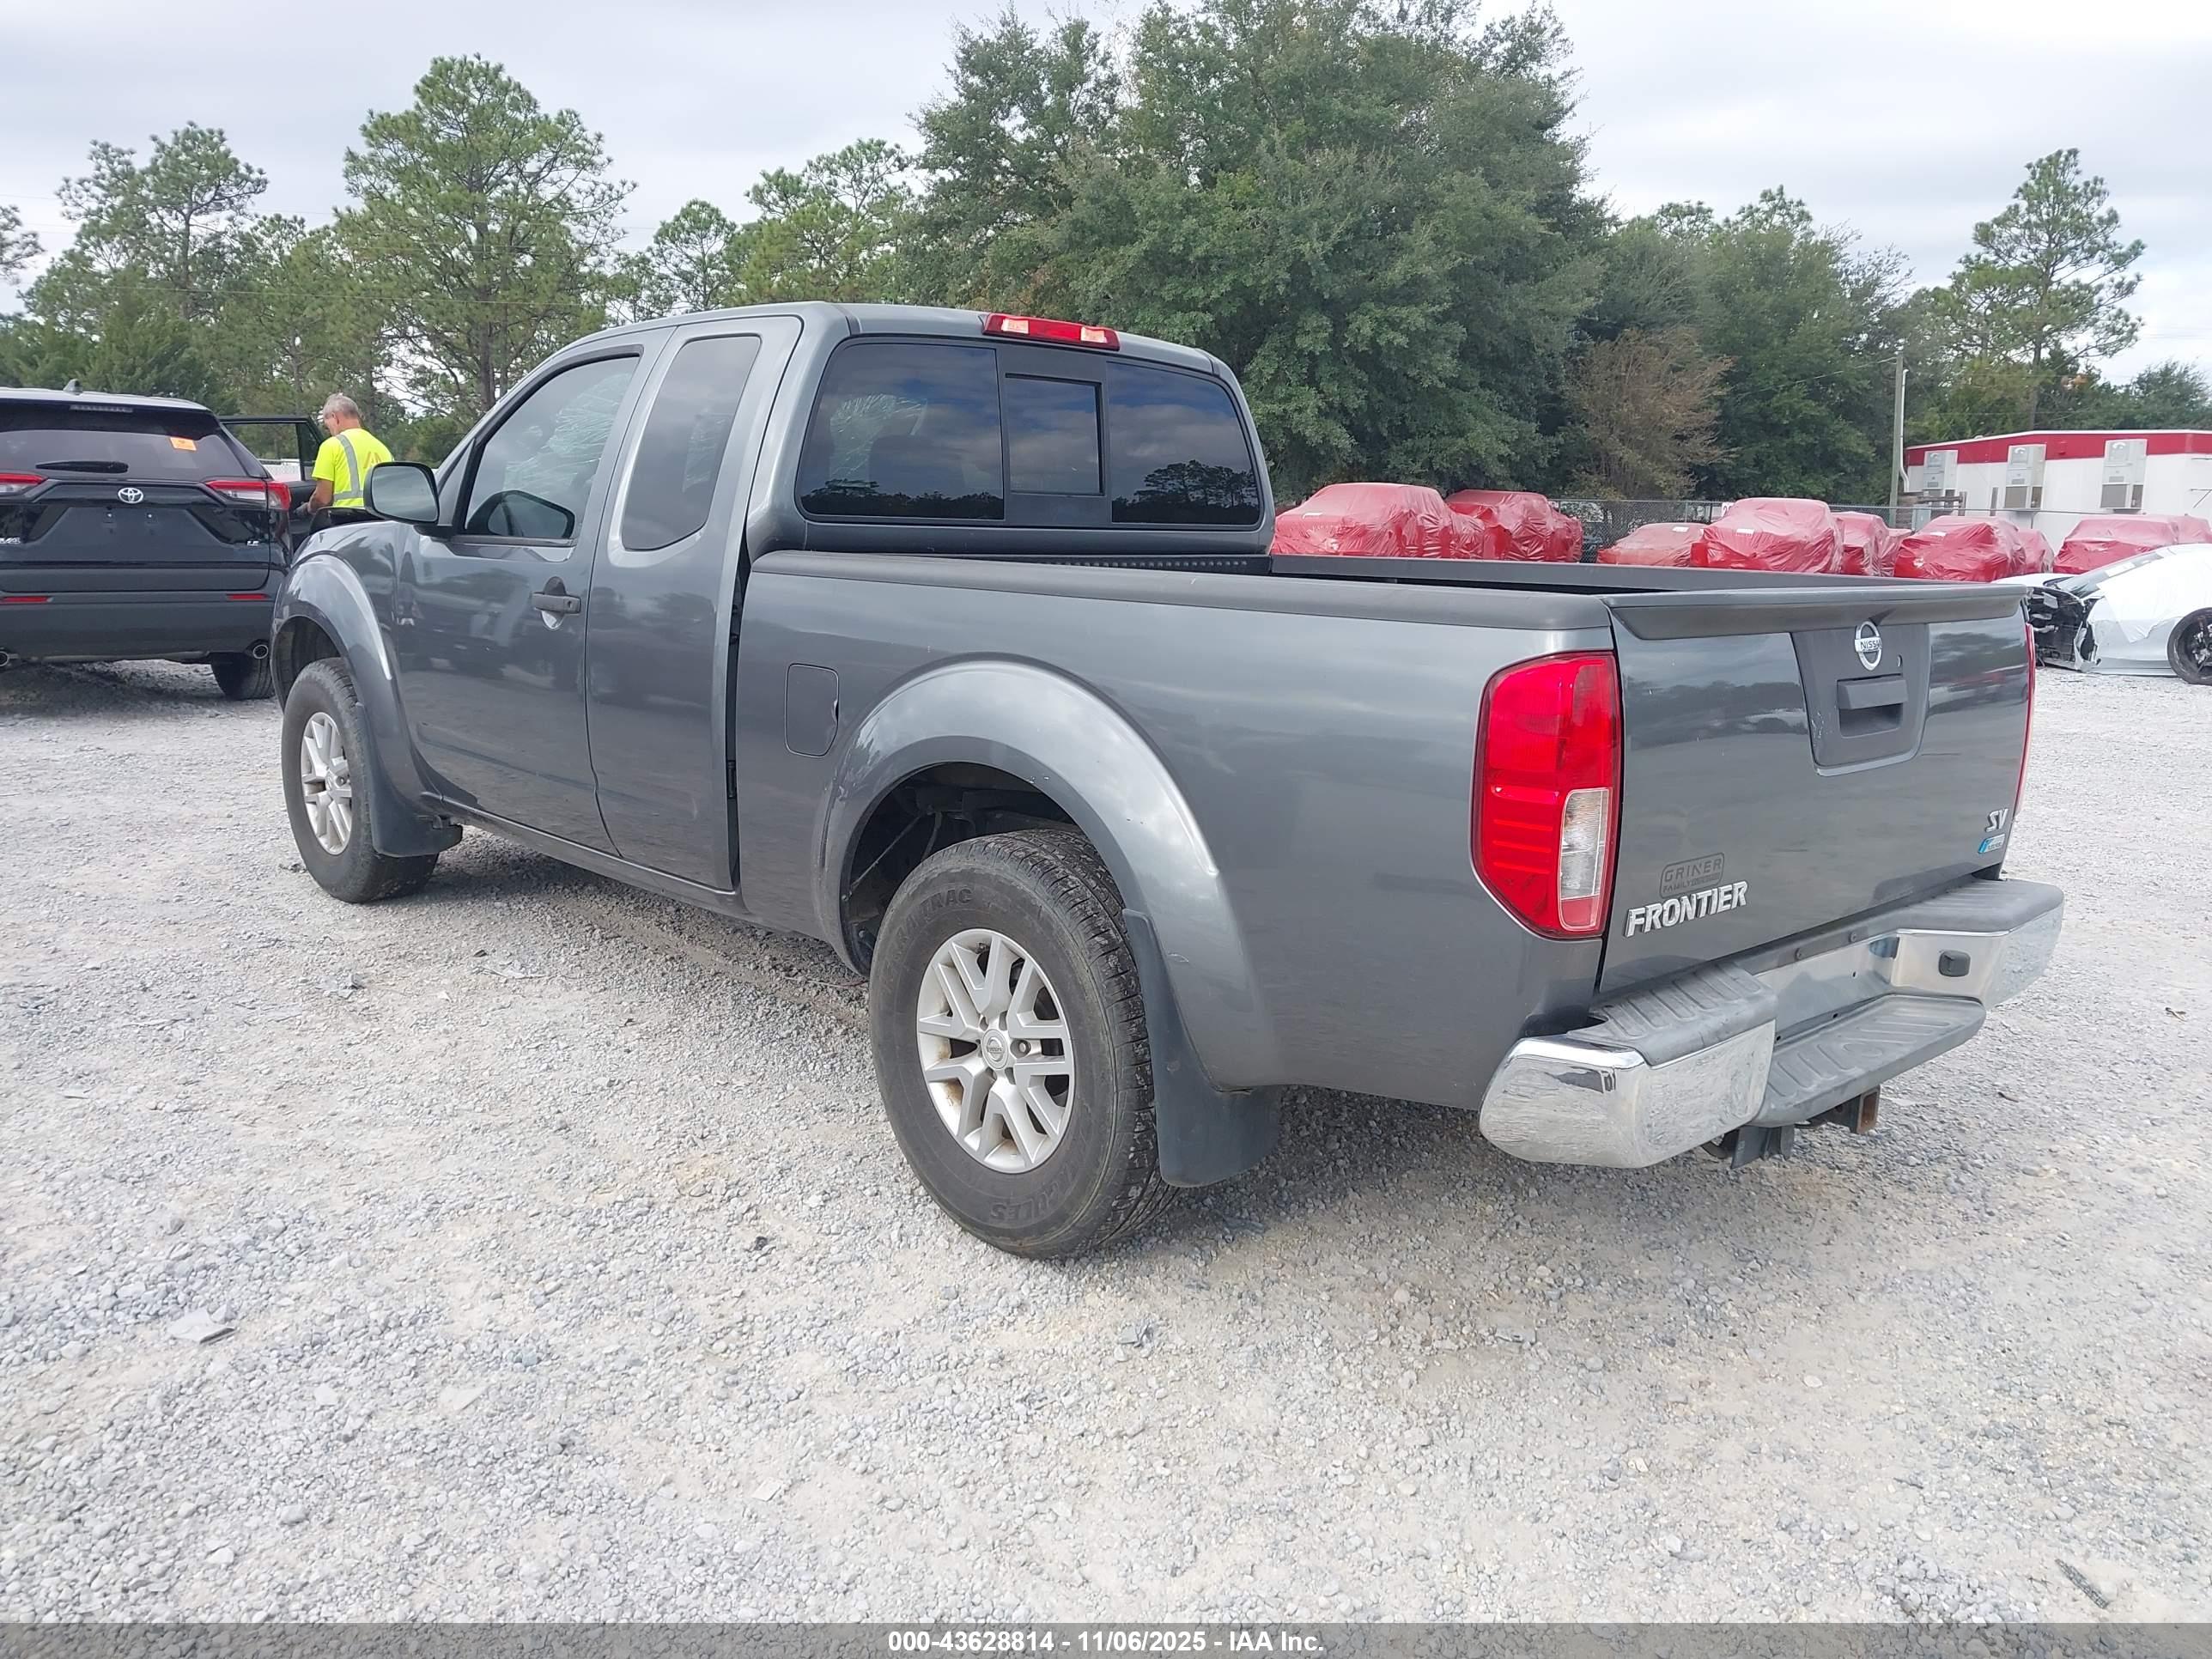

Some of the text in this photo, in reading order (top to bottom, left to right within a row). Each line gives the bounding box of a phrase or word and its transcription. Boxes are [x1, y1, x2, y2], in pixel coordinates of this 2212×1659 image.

[1984, 808, 2008, 832] SV
[1664, 858, 1723, 883] GRINER
[1624, 880, 1748, 938] FRONTIER
